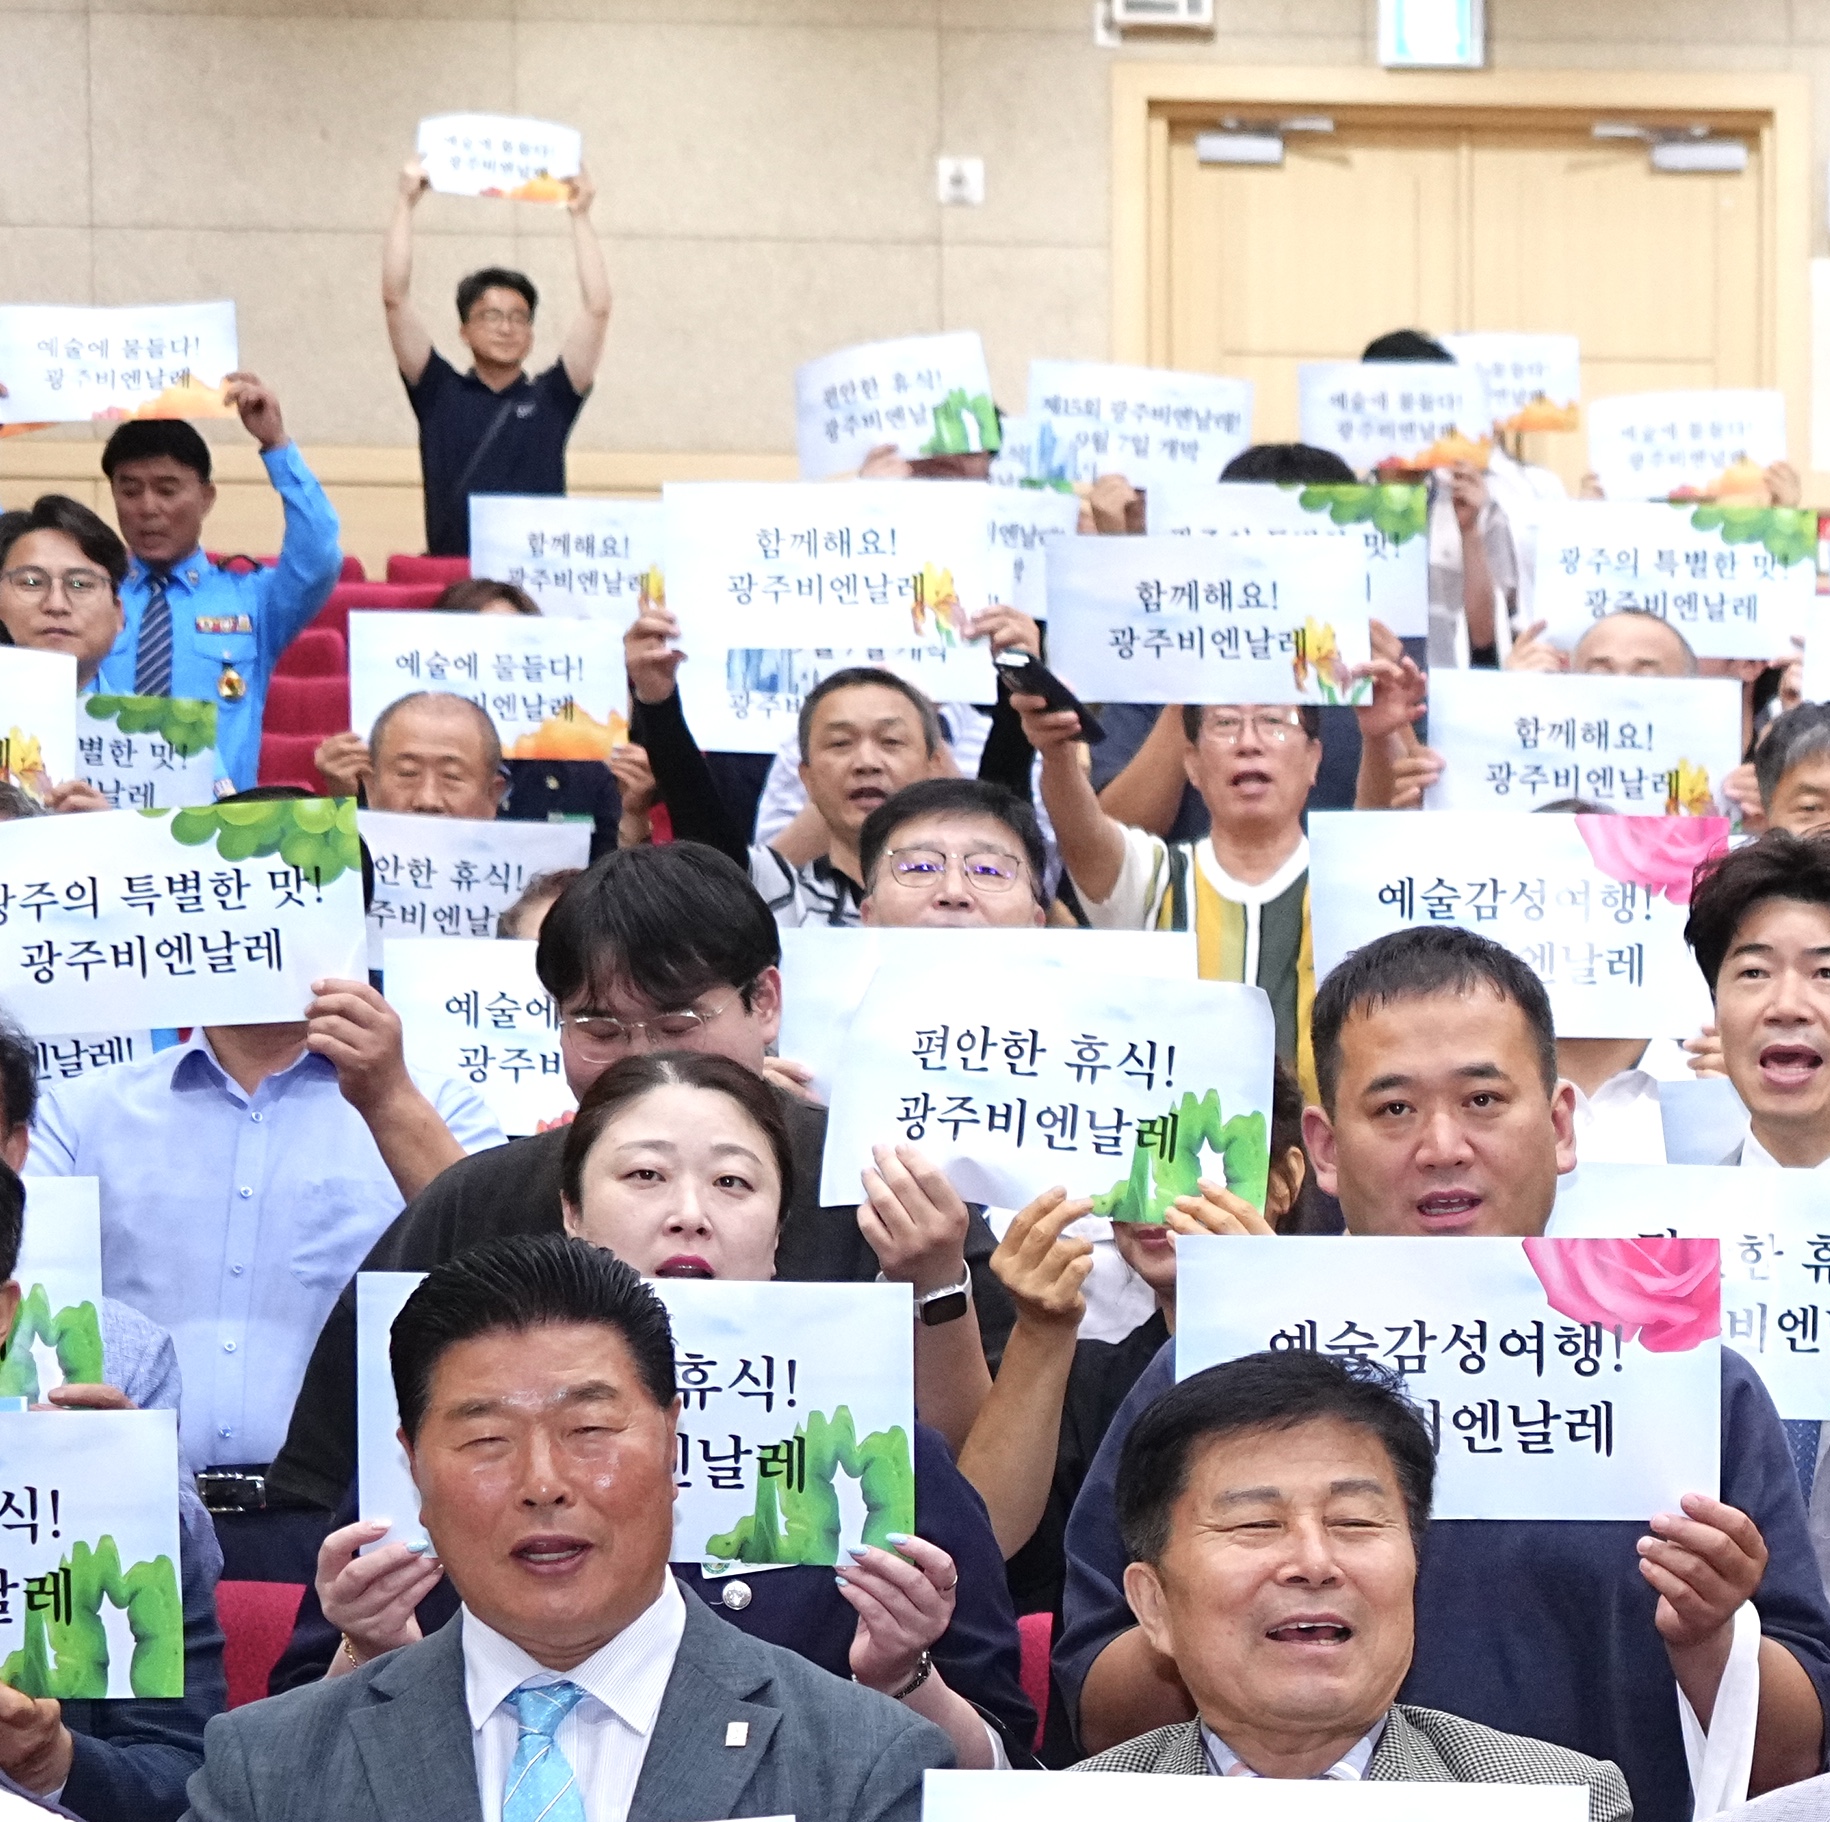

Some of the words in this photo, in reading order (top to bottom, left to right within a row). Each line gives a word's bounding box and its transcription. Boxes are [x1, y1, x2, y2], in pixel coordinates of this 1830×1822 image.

[37, 335, 110, 359] 예술에
[123, 335, 202, 359] 물들다!
[44, 365, 191, 391] 광주비엔날레
[527, 532, 631, 558] 함께해요!
[756, 527, 898, 559] 함께해요!
[1363, 532, 1401, 561] 맛!
[507, 567, 650, 595] 광주비엔날레
[1560, 547, 1639, 578] 광주의
[1656, 550, 1738, 579] 특별한
[1752, 554, 1790, 582] 맛!
[727, 572, 925, 606] 광주비엔날레
[1135, 581, 1279, 613] 함께해요!
[1584, 591, 1759, 623] 광주비엔날레
[1108, 626, 1307, 661] 광주비엔날레
[395, 651, 479, 682] 예술에
[491, 653, 585, 684] 물들다!
[1515, 719, 1655, 752] 함께해요!
[150, 741, 189, 773] 맛!
[1485, 761, 1681, 801] 광주비엔날레
[119, 868, 253, 916] 특별한
[267, 865, 325, 909] 맛!
[450, 862, 524, 894] 휴식!
[1378, 875, 1654, 925] 예술감성여행!
[20, 926, 285, 987] 광주비엔날레
[911, 1025, 1046, 1074] 편안한
[1064, 1032, 1176, 1091] 휴식!
[896, 1093, 1180, 1166] 광주비엔날레
[676, 1350, 798, 1414] 휴식!
